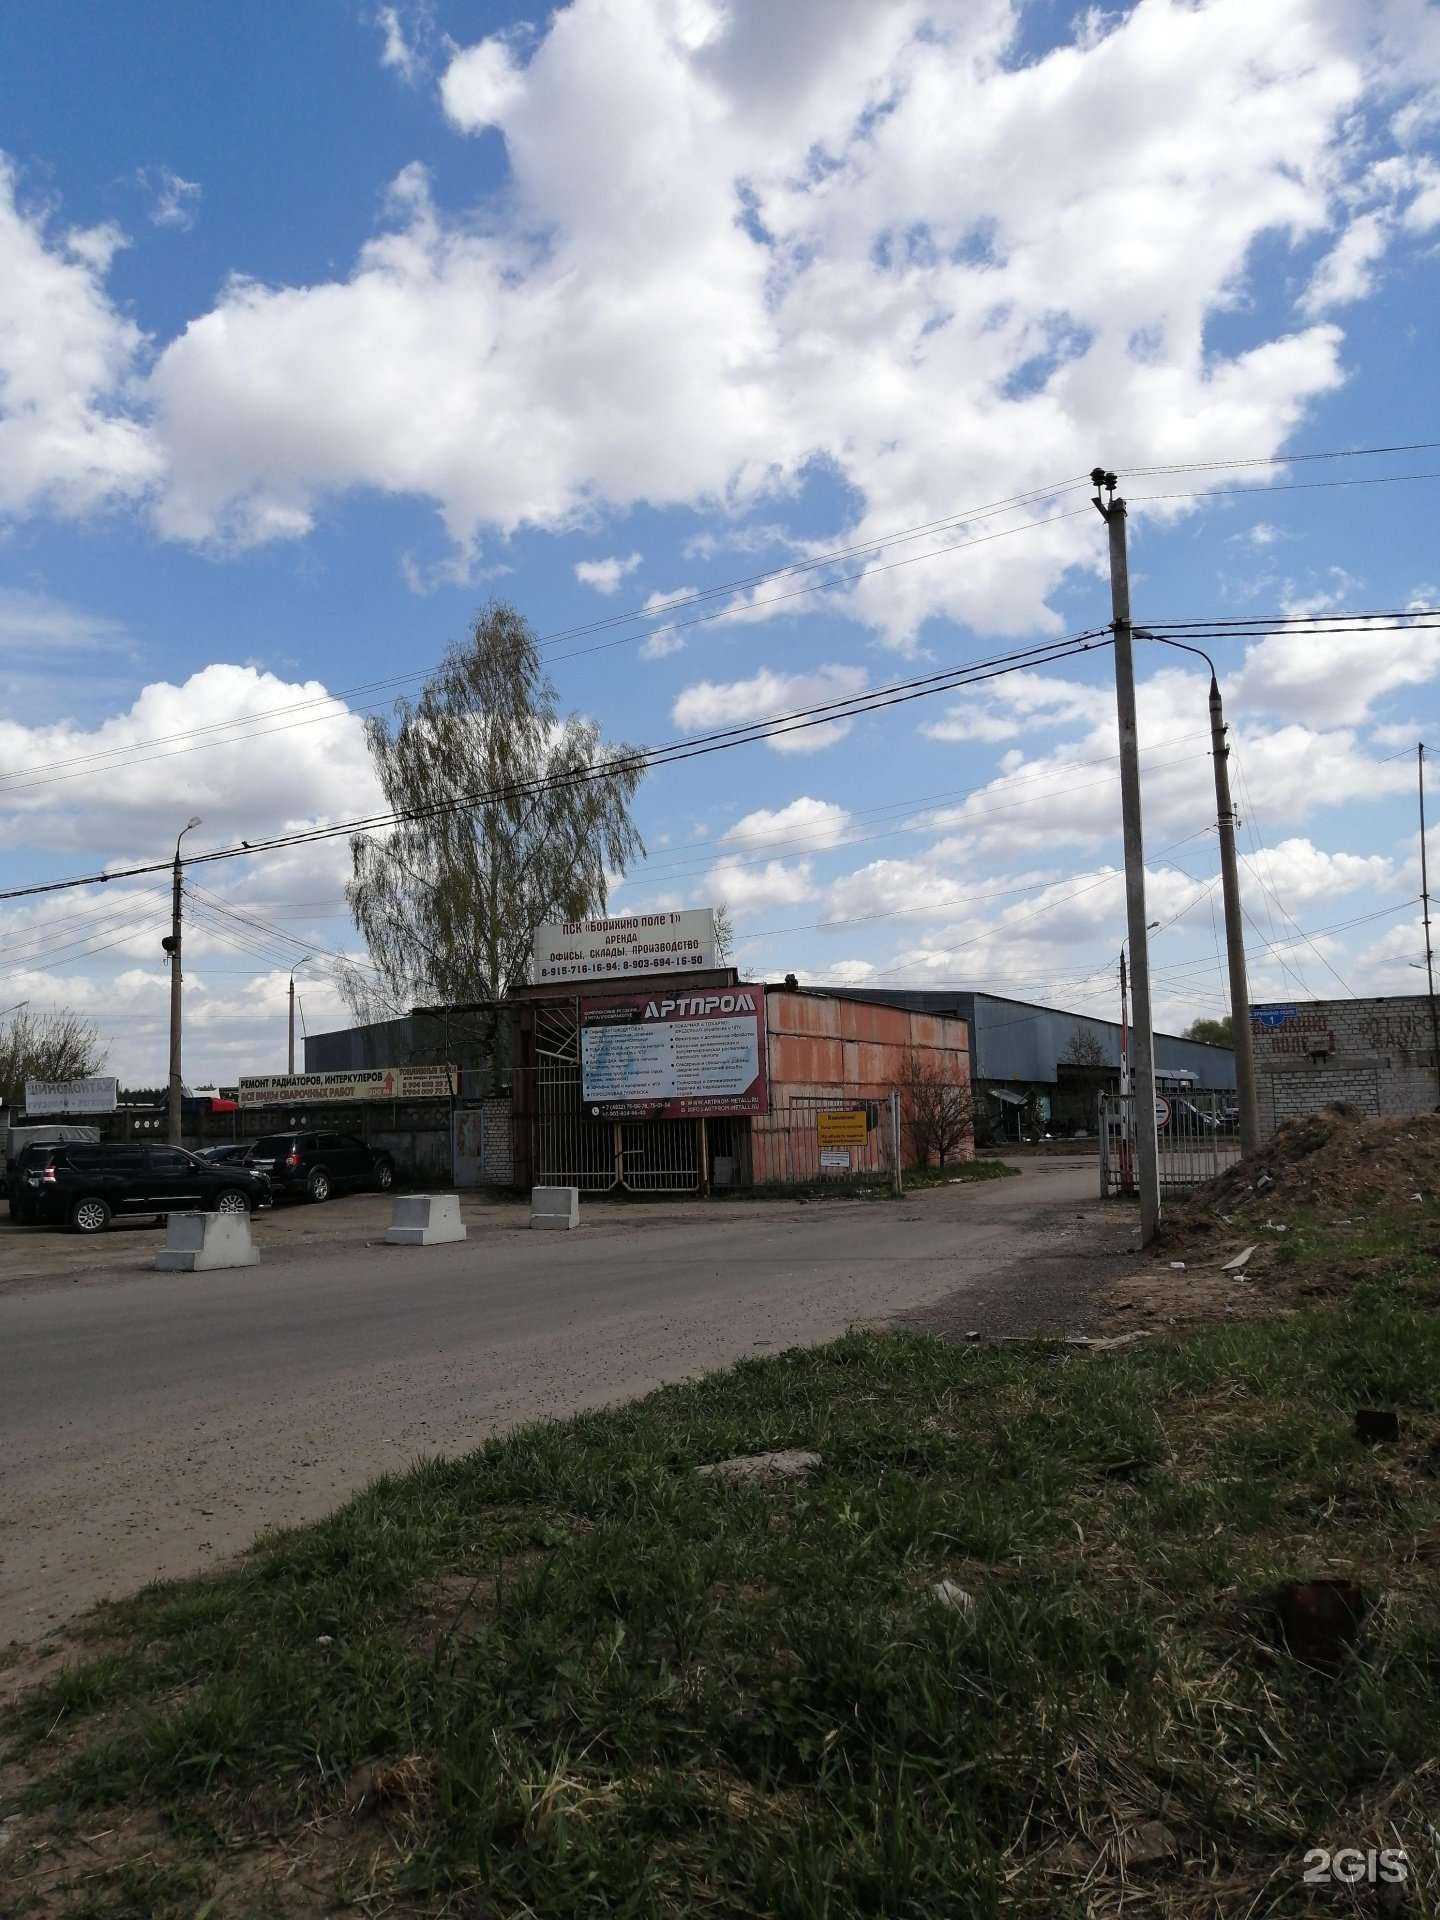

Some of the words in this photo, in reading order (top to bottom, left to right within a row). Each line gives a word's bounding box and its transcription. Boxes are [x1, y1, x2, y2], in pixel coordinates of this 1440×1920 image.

[562, 922, 582, 935] ПСК
[641, 915, 666, 927] поле
[605, 933, 638, 945] АРЕНДА
[632, 939, 699, 955] ПРОИЗВОДСТВО
[644, 993, 756, 1018] АРТПРОМ
[1269, 1015, 1274, 1025] 1
[240, 1078, 270, 1089] РЕМОНТ
[271, 1076, 323, 1088] РАДИАТОРОВ,
[324, 1072, 383, 1085] ИНТЕРКУЛЕРОВ
[329, 1086, 355, 1097] РАБОТ
